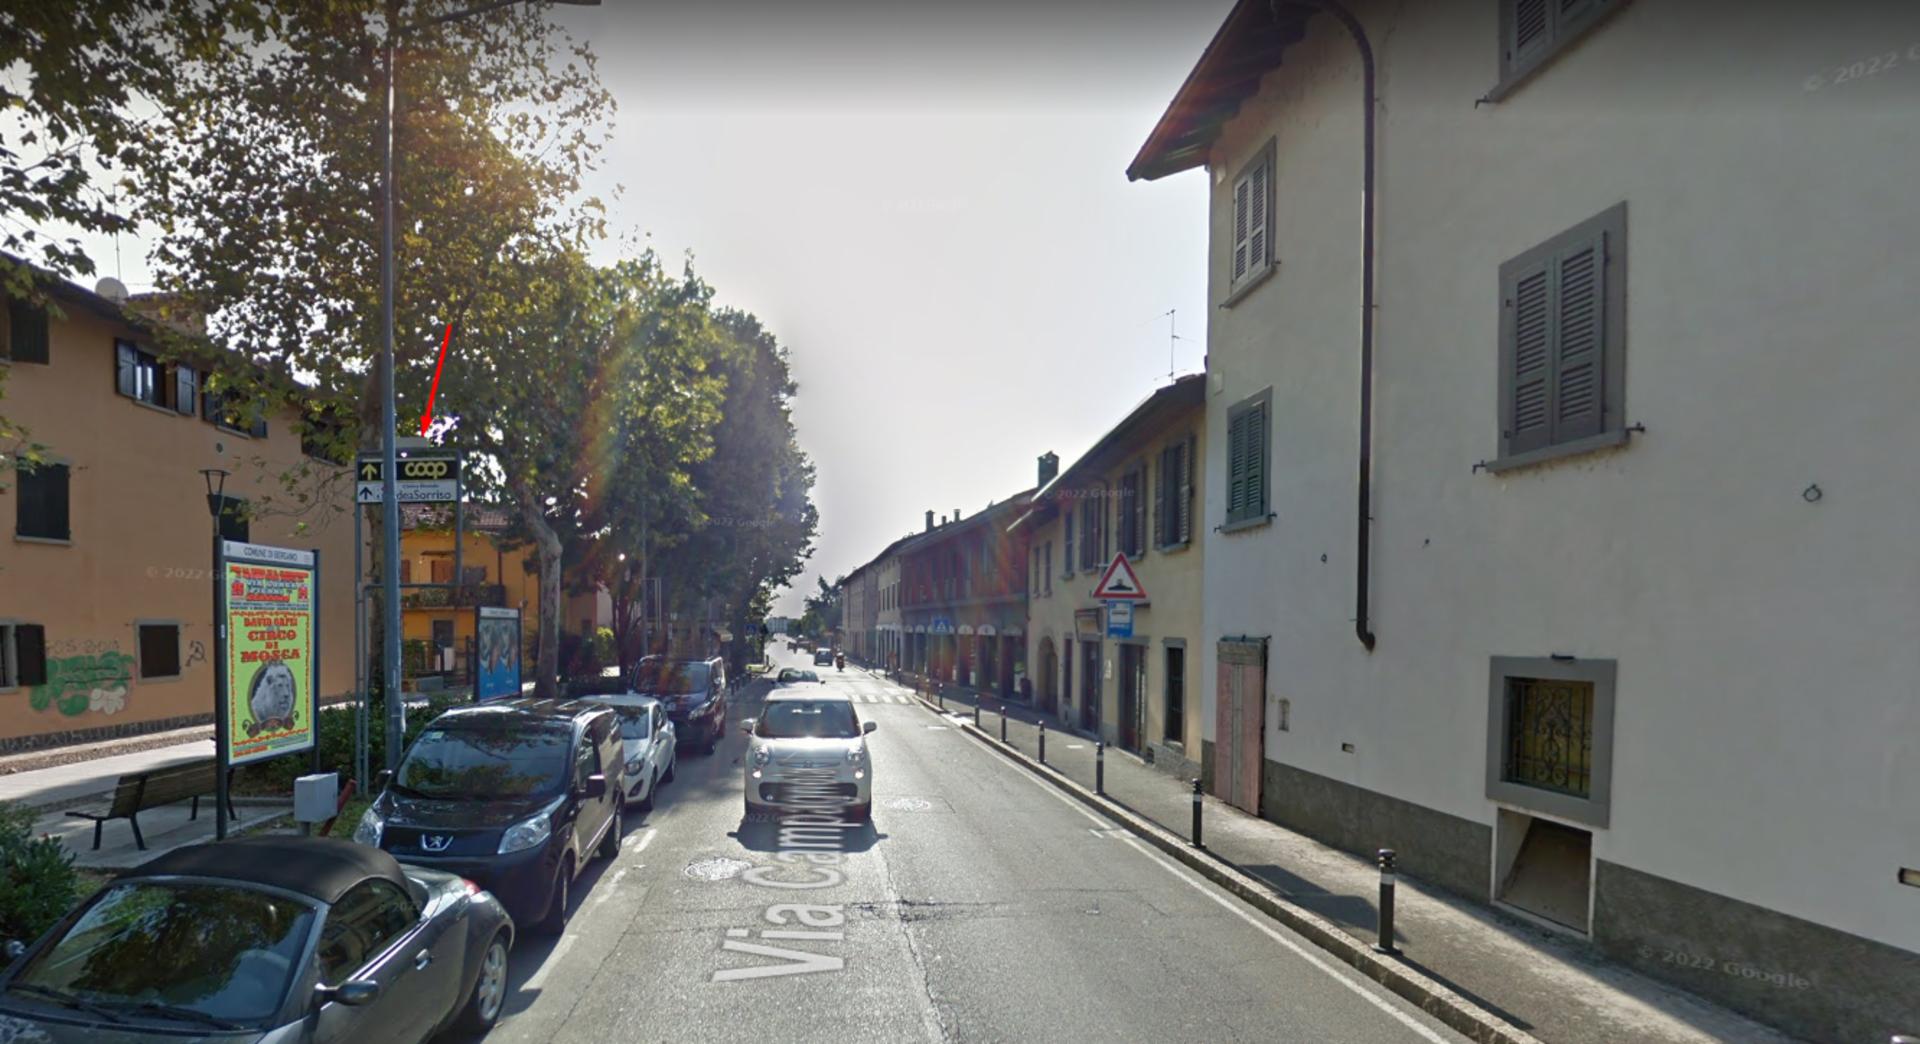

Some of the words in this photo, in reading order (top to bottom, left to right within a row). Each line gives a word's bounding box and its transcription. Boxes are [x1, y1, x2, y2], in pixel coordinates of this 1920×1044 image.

[405, 462, 447, 479] coop
[396, 489, 452, 500] deaSorriso
[248, 630, 296, 641] CIRCO
[240, 649, 300, 663] MOSCA
